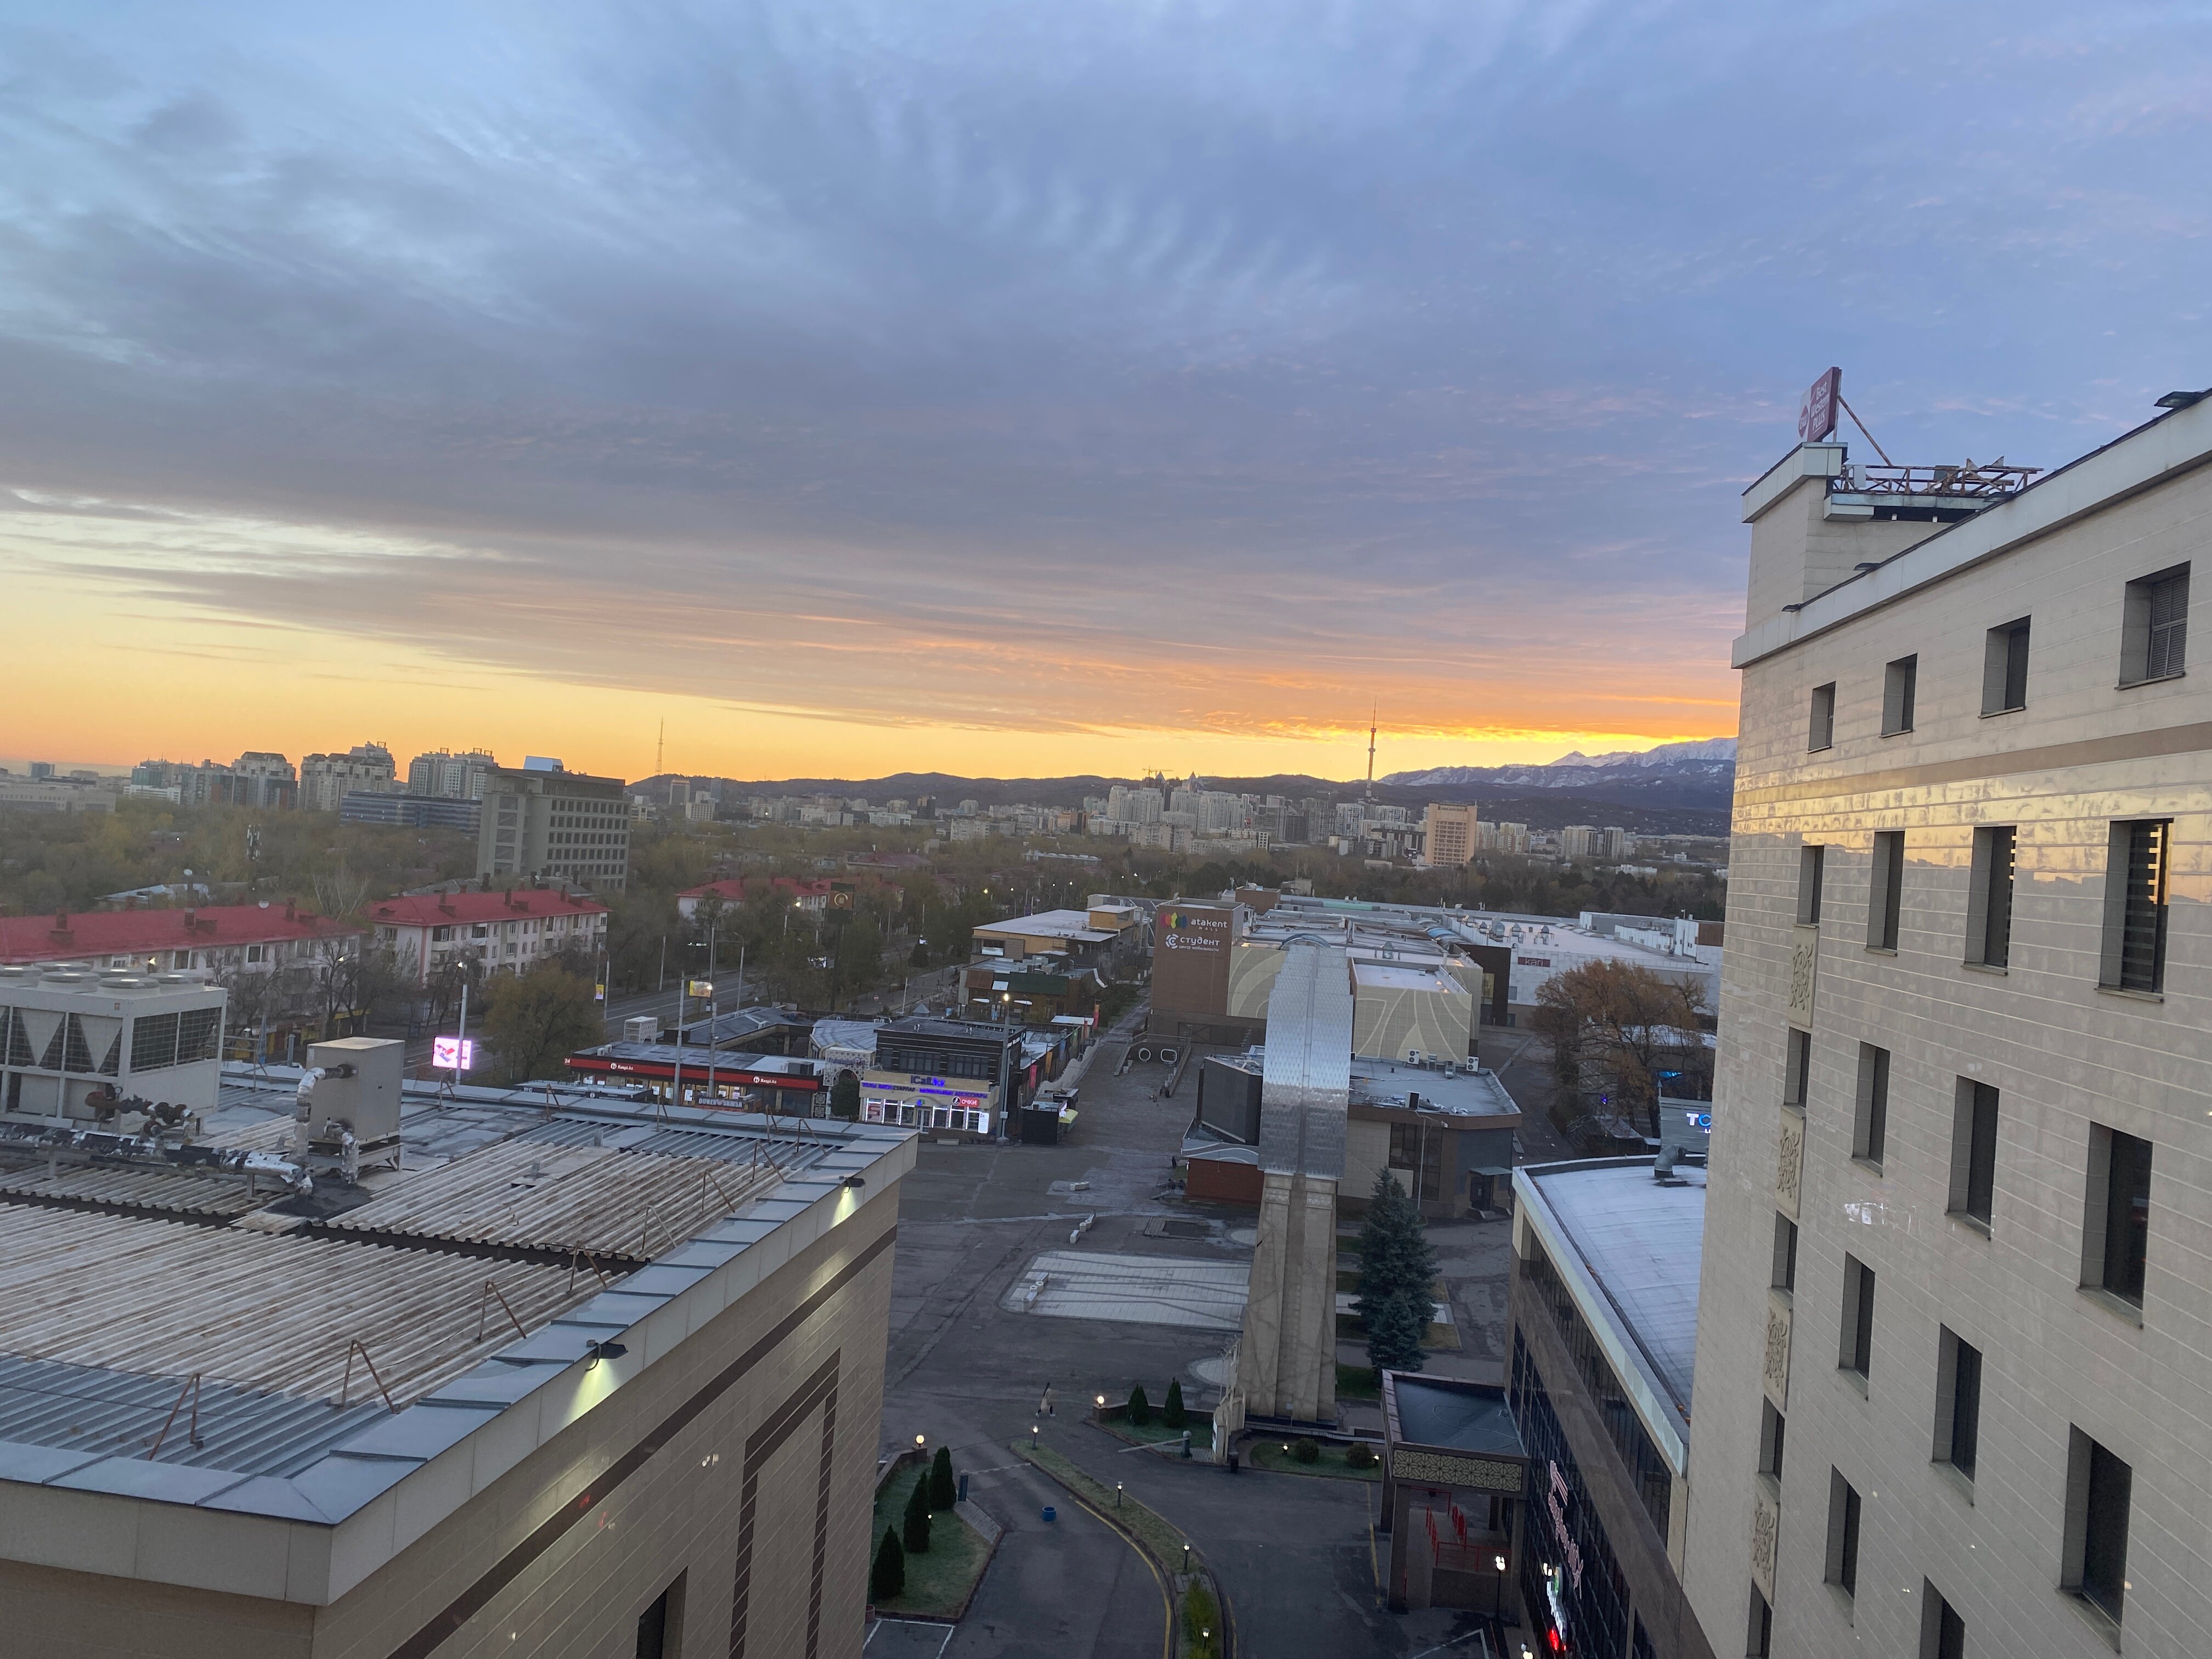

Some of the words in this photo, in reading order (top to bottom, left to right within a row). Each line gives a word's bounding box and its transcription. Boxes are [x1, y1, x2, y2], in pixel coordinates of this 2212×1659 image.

[1816, 382, 1827, 400] Best
[1190, 918, 1228, 928] atakent
[1180, 936, 1220, 946] студент
[1525, 957, 1543, 967] kari
